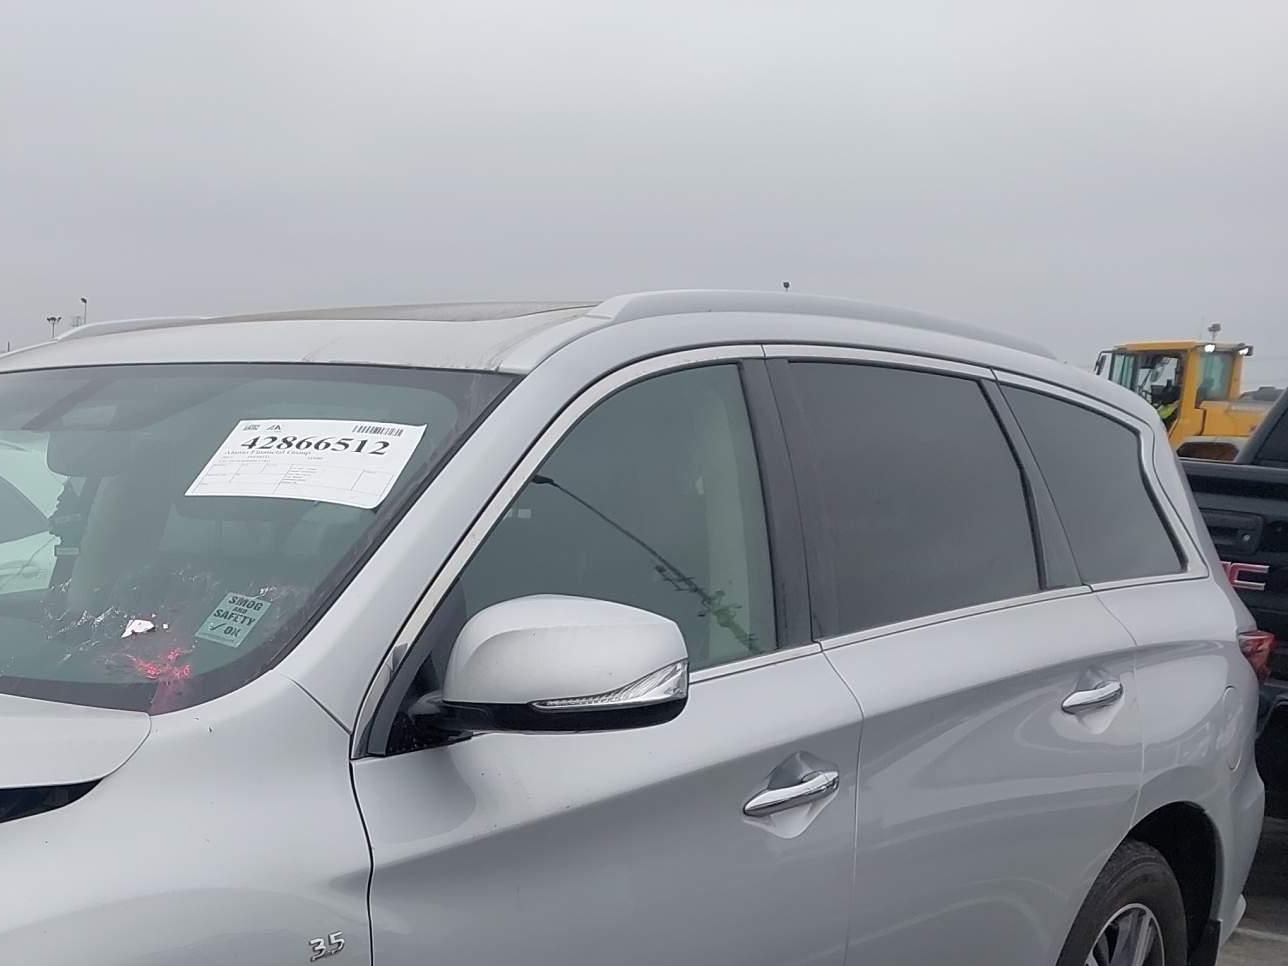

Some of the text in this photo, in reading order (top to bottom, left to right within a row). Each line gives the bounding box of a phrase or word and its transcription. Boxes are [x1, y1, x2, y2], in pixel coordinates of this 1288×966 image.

[241, 435, 390, 455] 42866512
[228, 596, 263, 611] SMOG
[213, 609, 257, 626] SAFETY
[223, 626, 241, 637] OK
